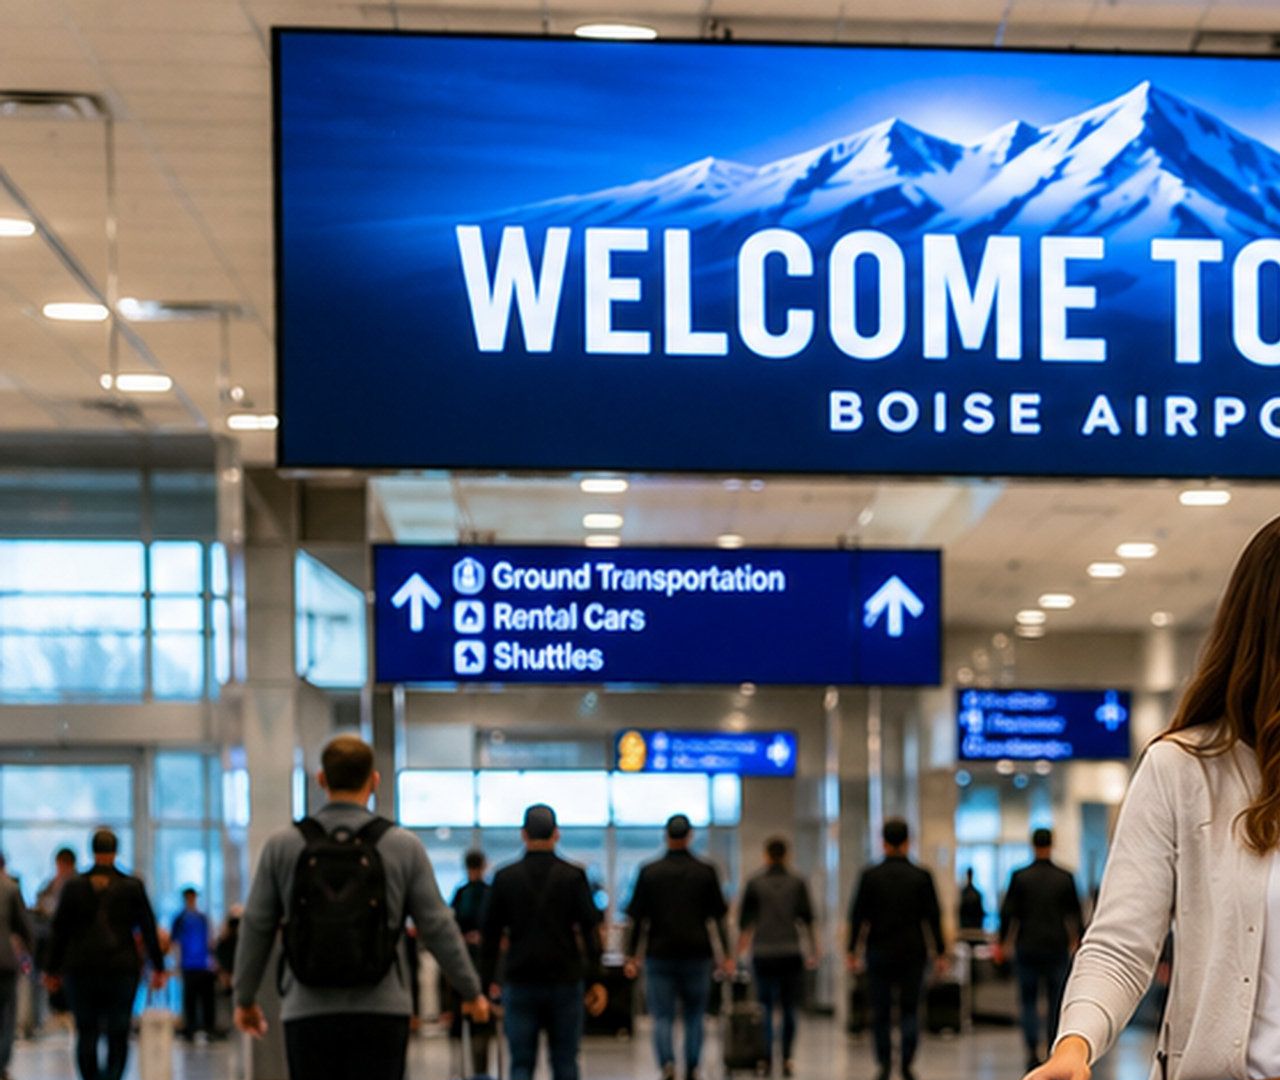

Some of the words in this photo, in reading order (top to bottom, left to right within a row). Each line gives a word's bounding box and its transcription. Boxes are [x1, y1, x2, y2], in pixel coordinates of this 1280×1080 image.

[456, 226, 1105, 361] WELCOME
[830, 391, 1040, 434] BOISE
[492, 562, 591, 590] Ground
[596, 563, 785, 597] Transportation
[494, 602, 577, 630] Rental
[583, 603, 646, 632] Cars
[494, 641, 604, 671] Shuttles
